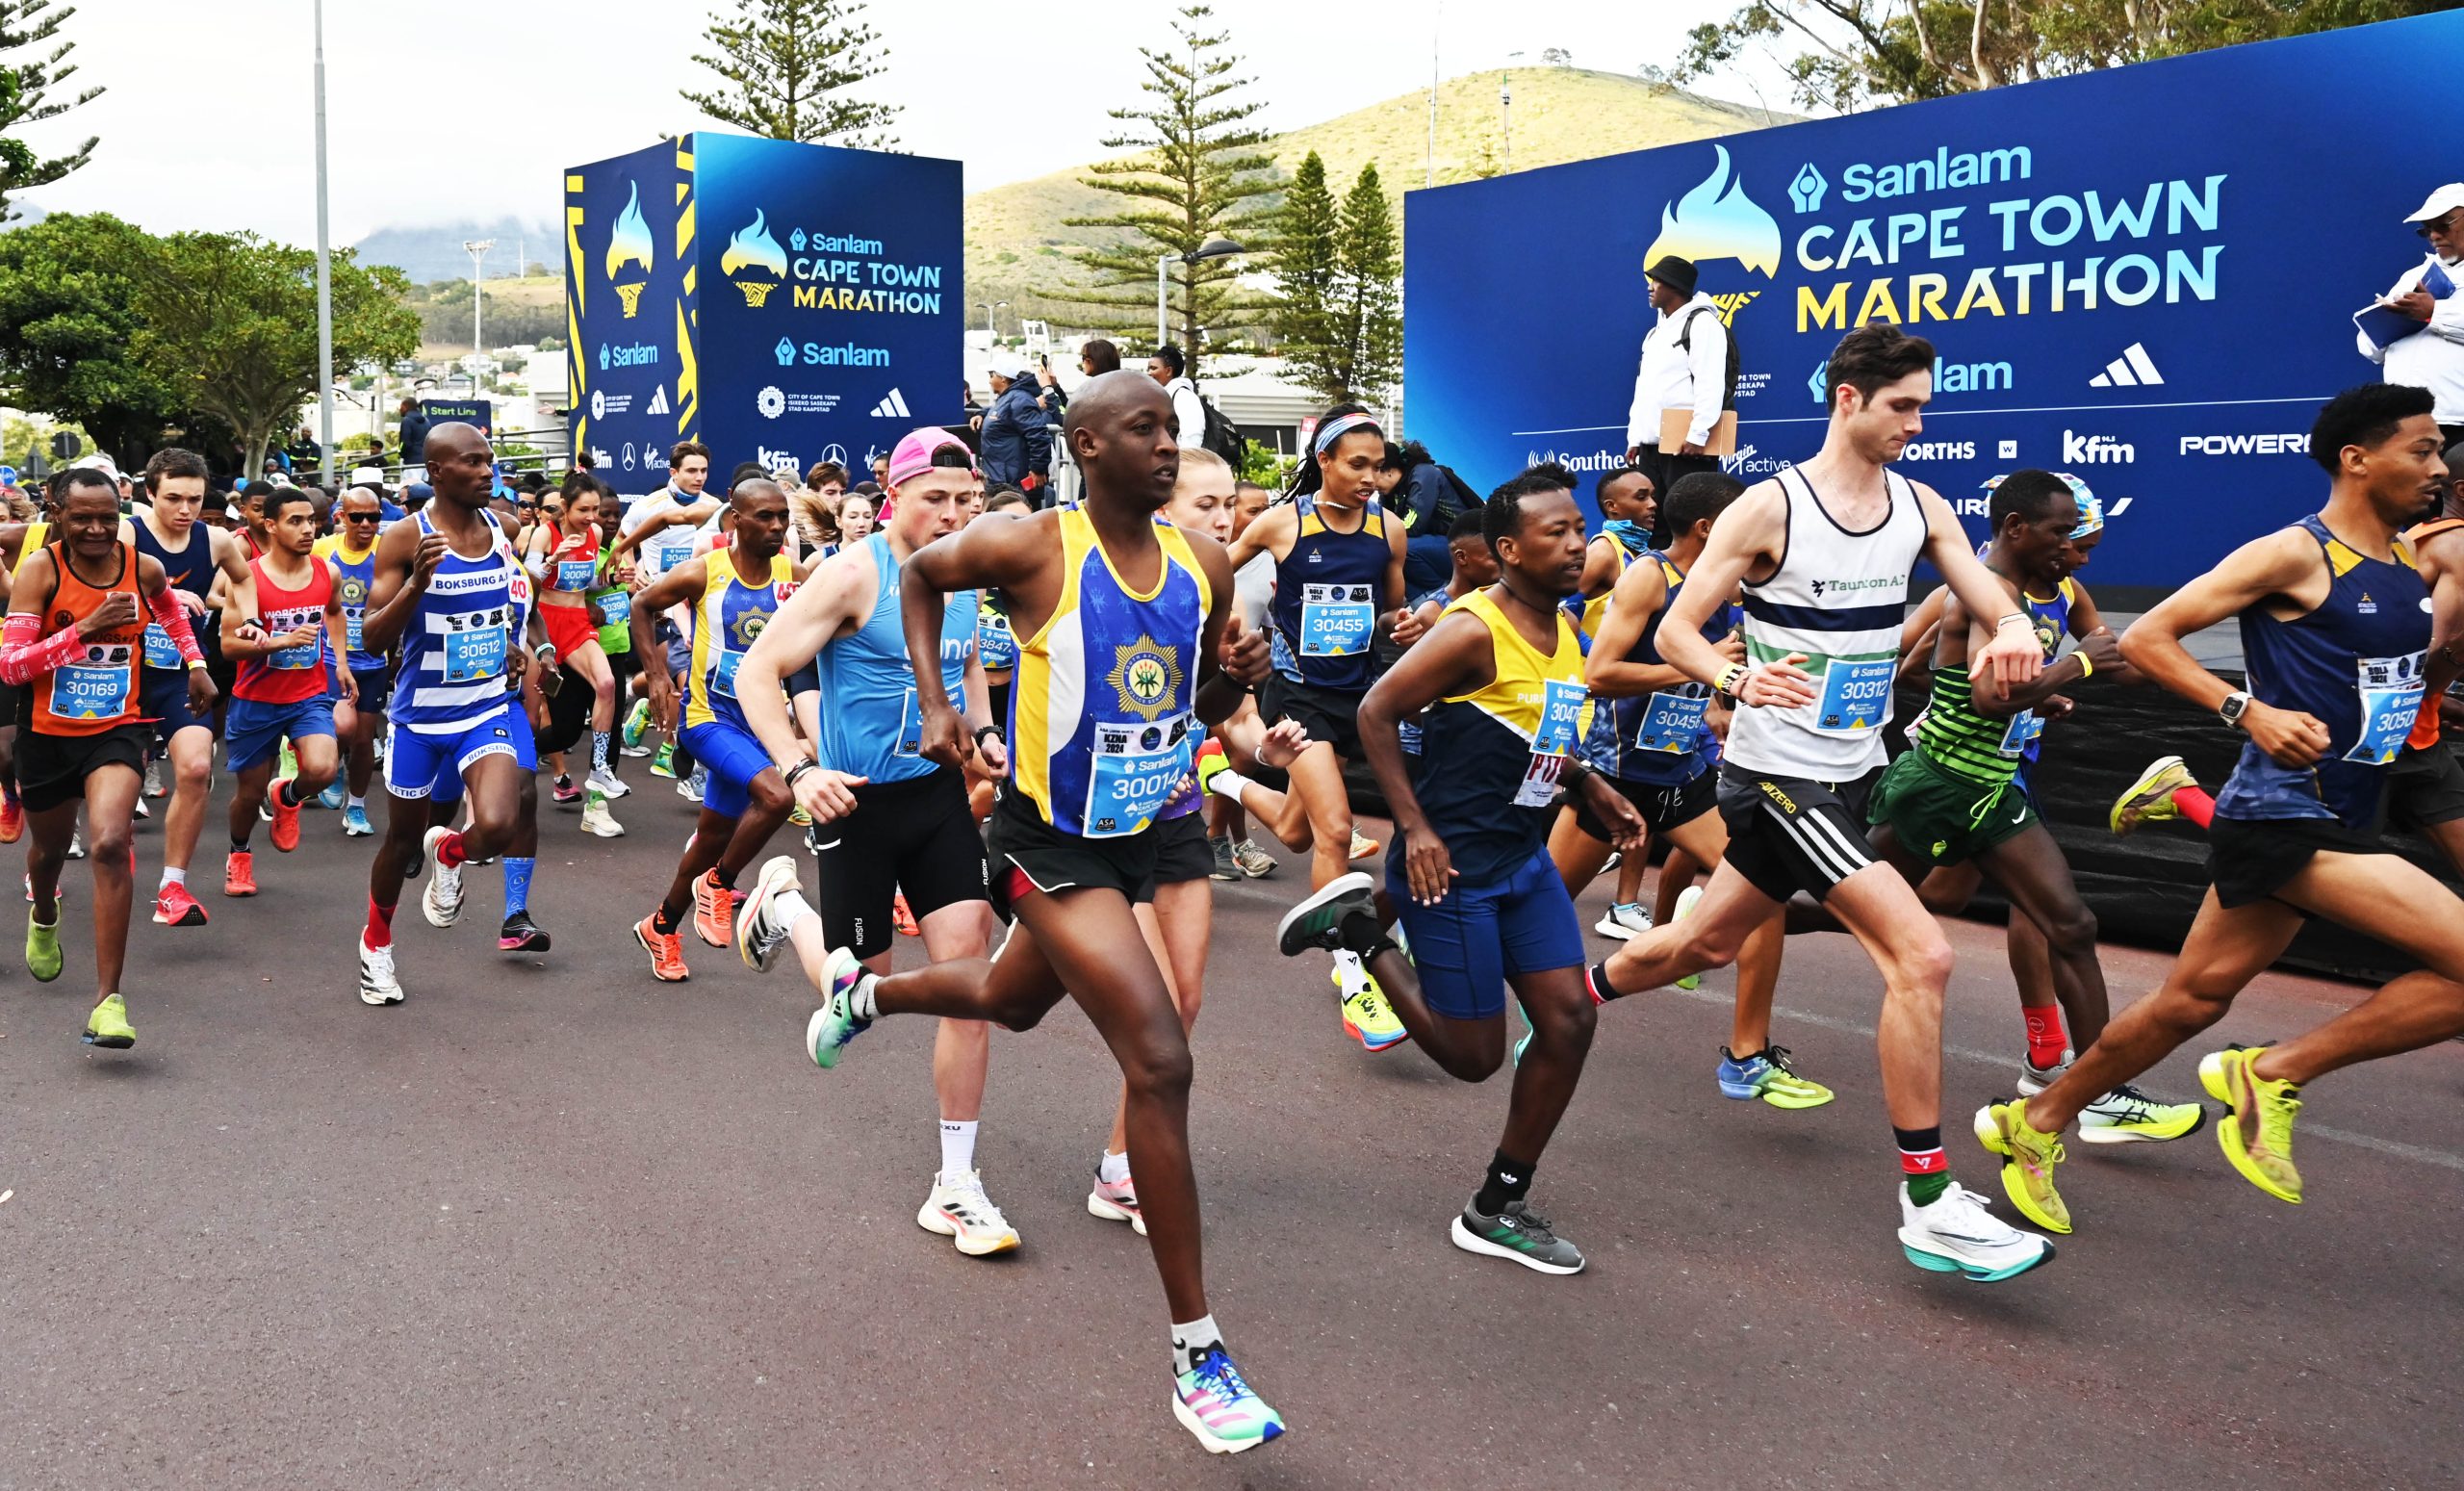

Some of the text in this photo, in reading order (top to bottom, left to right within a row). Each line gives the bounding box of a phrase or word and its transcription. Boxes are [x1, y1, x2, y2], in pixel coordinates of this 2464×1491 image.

[1842, 145, 2032, 203] Sanlam
[1796, 174, 2227, 271] CAPE TOWN
[812, 233, 883, 255] Sanlam
[793, 257, 942, 288] CAPE TOWN
[1796, 245, 2226, 333] MARATHON
[793, 285, 941, 315] MARATHON
[613, 342, 658, 368] Sanlam
[803, 342, 889, 367] Sanlam
[1931, 356, 2013, 394] lam
[430, 407, 454, 416] Start
[2063, 429, 2134, 464] kfm
[1559, 450, 1630, 472] Southe
[1719, 445, 1758, 476] Virgin
[1746, 456, 1791, 473] active
[436, 576, 496, 589] BOKSBURG
[511, 579, 526, 599] 40
[471, 631, 498, 641] Sanlam
[1313, 619, 1364, 632] 30455
[458, 640, 500, 658] 30612
[84, 672, 115, 681] Sanlam
[1861, 666, 1889, 677] Sanlam
[66, 681, 117, 696] 30169
[1840, 680, 1889, 700] 30312
[2376, 707, 2418, 733] 3050
[1104, 734, 1127, 743] KZNA
[1106, 744, 1124, 753] 2024
[1138, 755, 1178, 771] Sanlam
[1112, 767, 1180, 800] 30014
